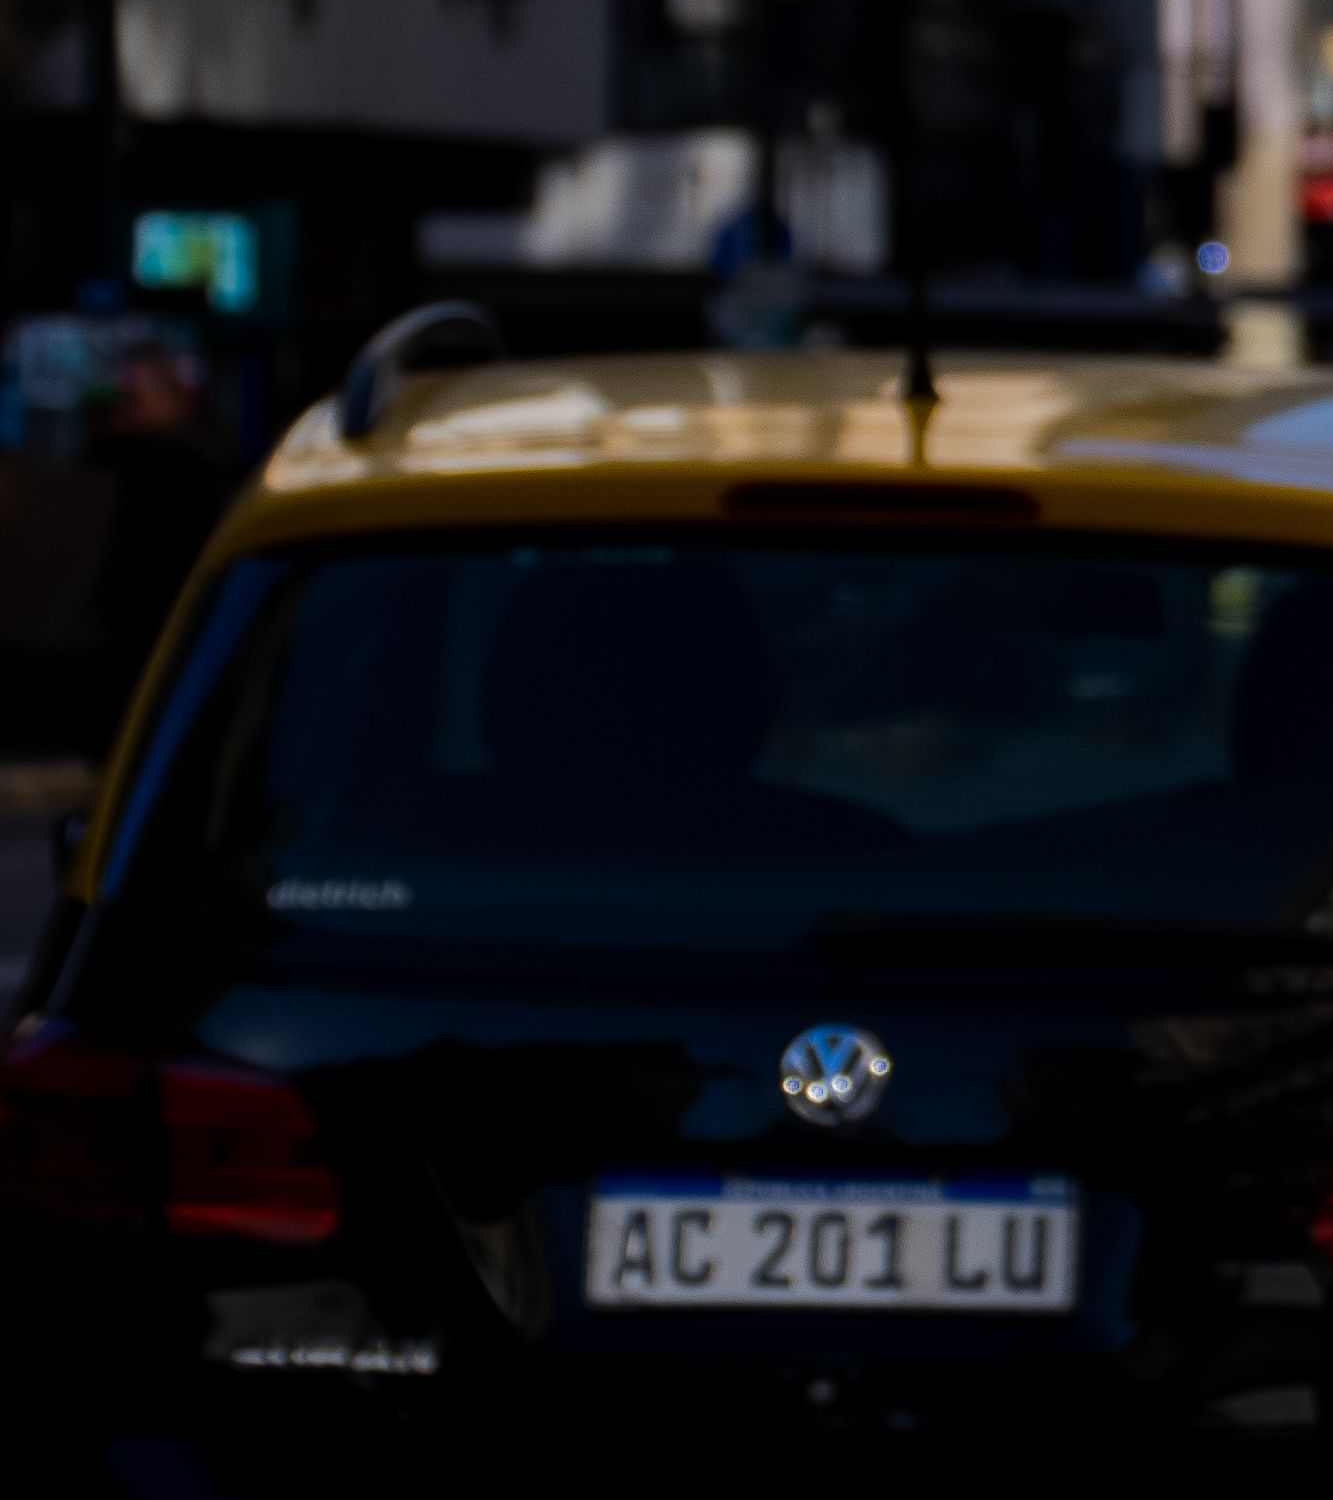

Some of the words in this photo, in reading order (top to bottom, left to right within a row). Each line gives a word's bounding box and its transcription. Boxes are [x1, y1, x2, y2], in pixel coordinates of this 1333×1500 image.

[614, 1208, 716, 1290] AC
[749, 1209, 909, 1291] 201
[945, 1211, 1049, 1293] LU
